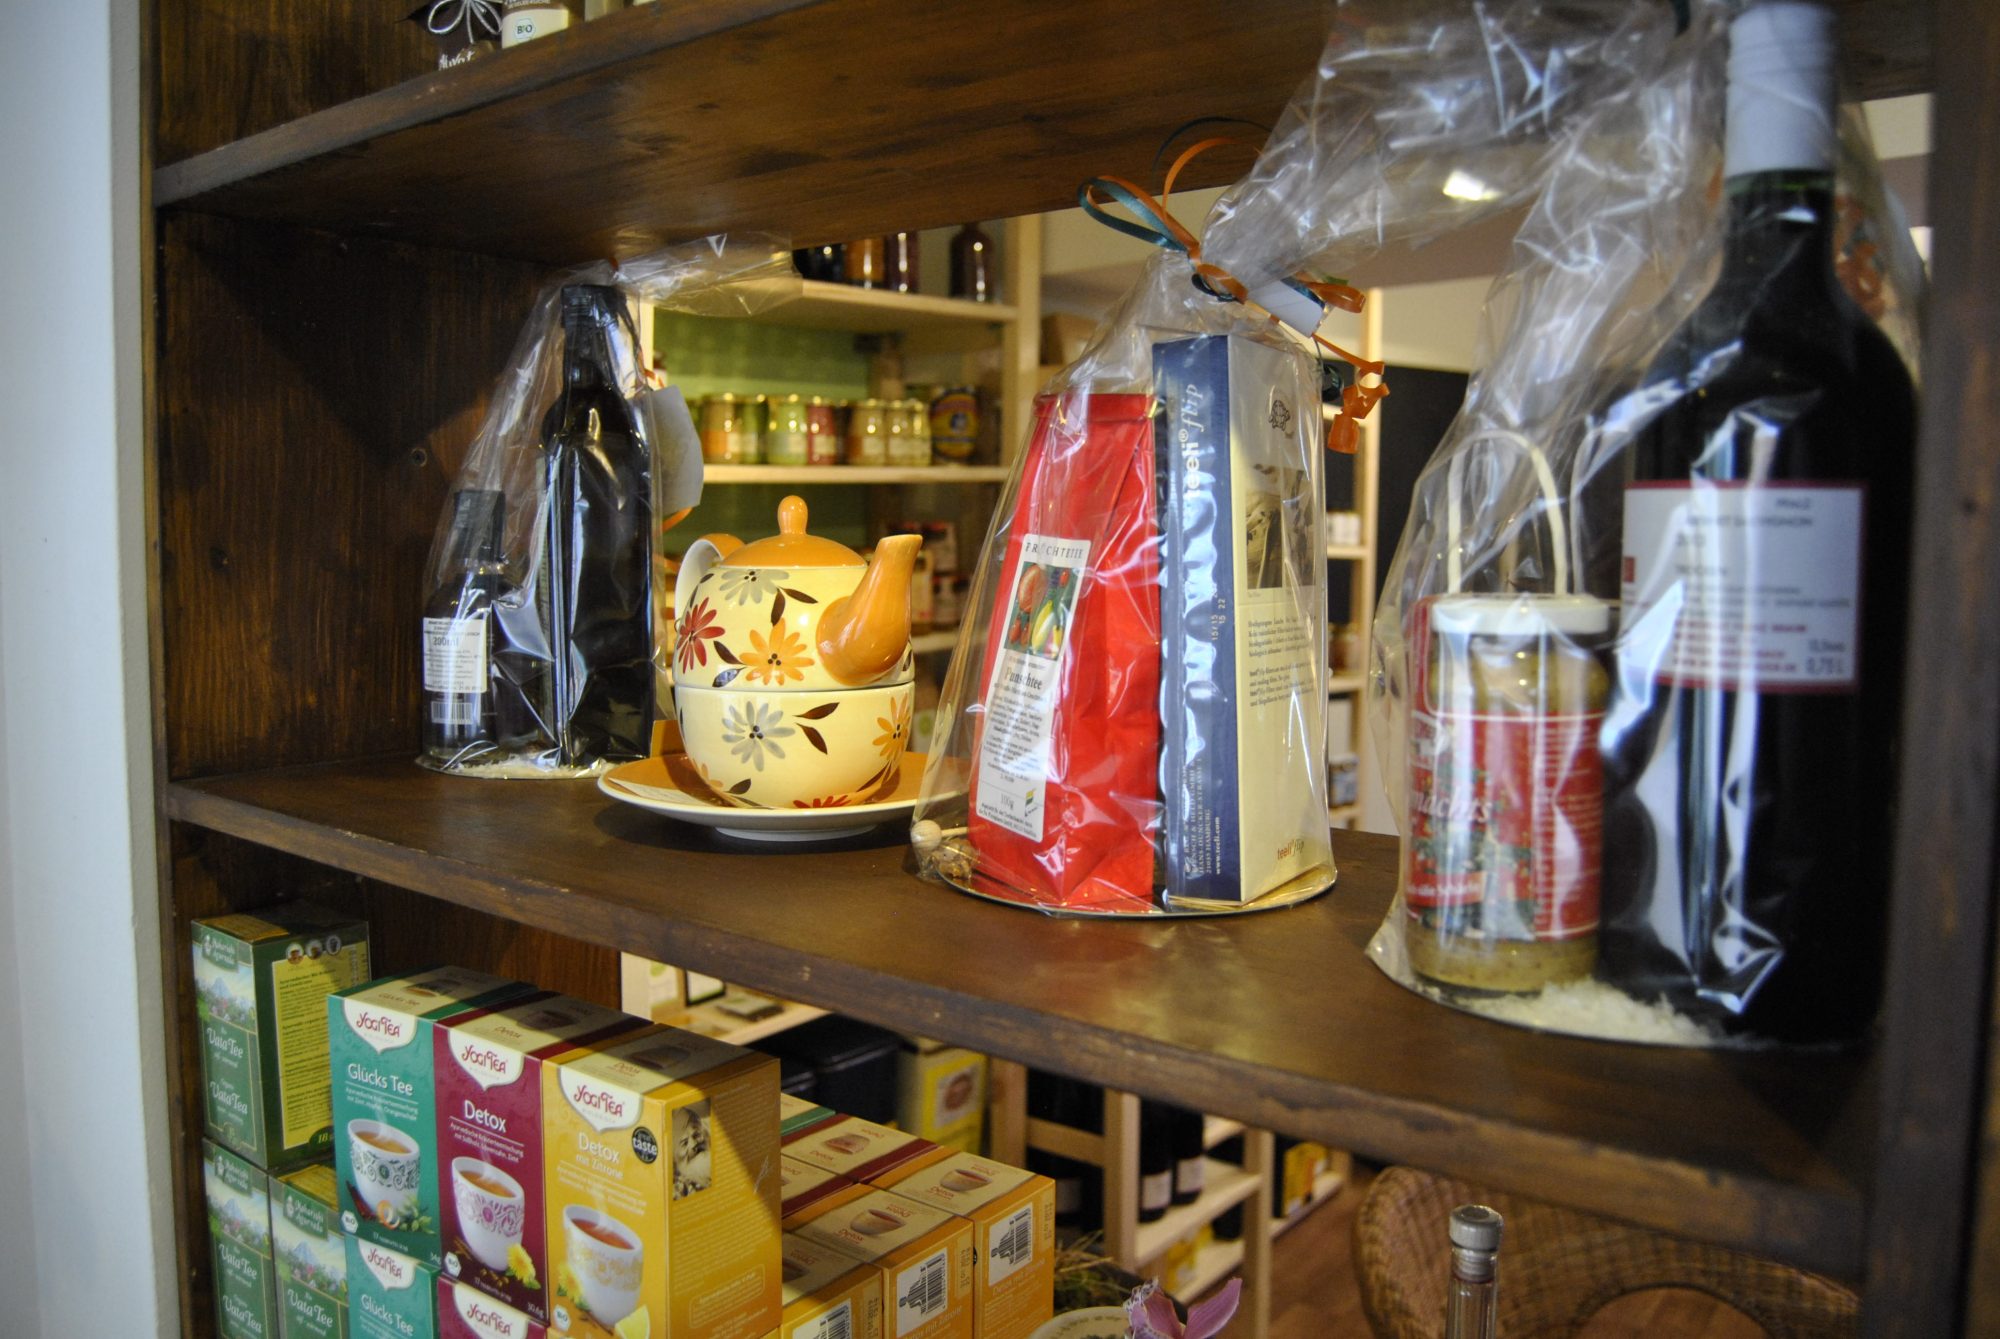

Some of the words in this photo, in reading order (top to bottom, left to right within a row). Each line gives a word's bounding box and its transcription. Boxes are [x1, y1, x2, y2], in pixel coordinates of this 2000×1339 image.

[1004, 666, 1043, 690] Punshtee
[347, 1063, 388, 1088] Glücks
[389, 1075, 413, 1096] Tee
[464, 1099, 507, 1133] Detox
[579, 1132, 620, 1164] Detox
[632, 1137, 658, 1156] taste
[313, 1304, 334, 1328] Tee
[361, 1294, 393, 1325] Glücks
[393, 1311, 414, 1337] Tee
